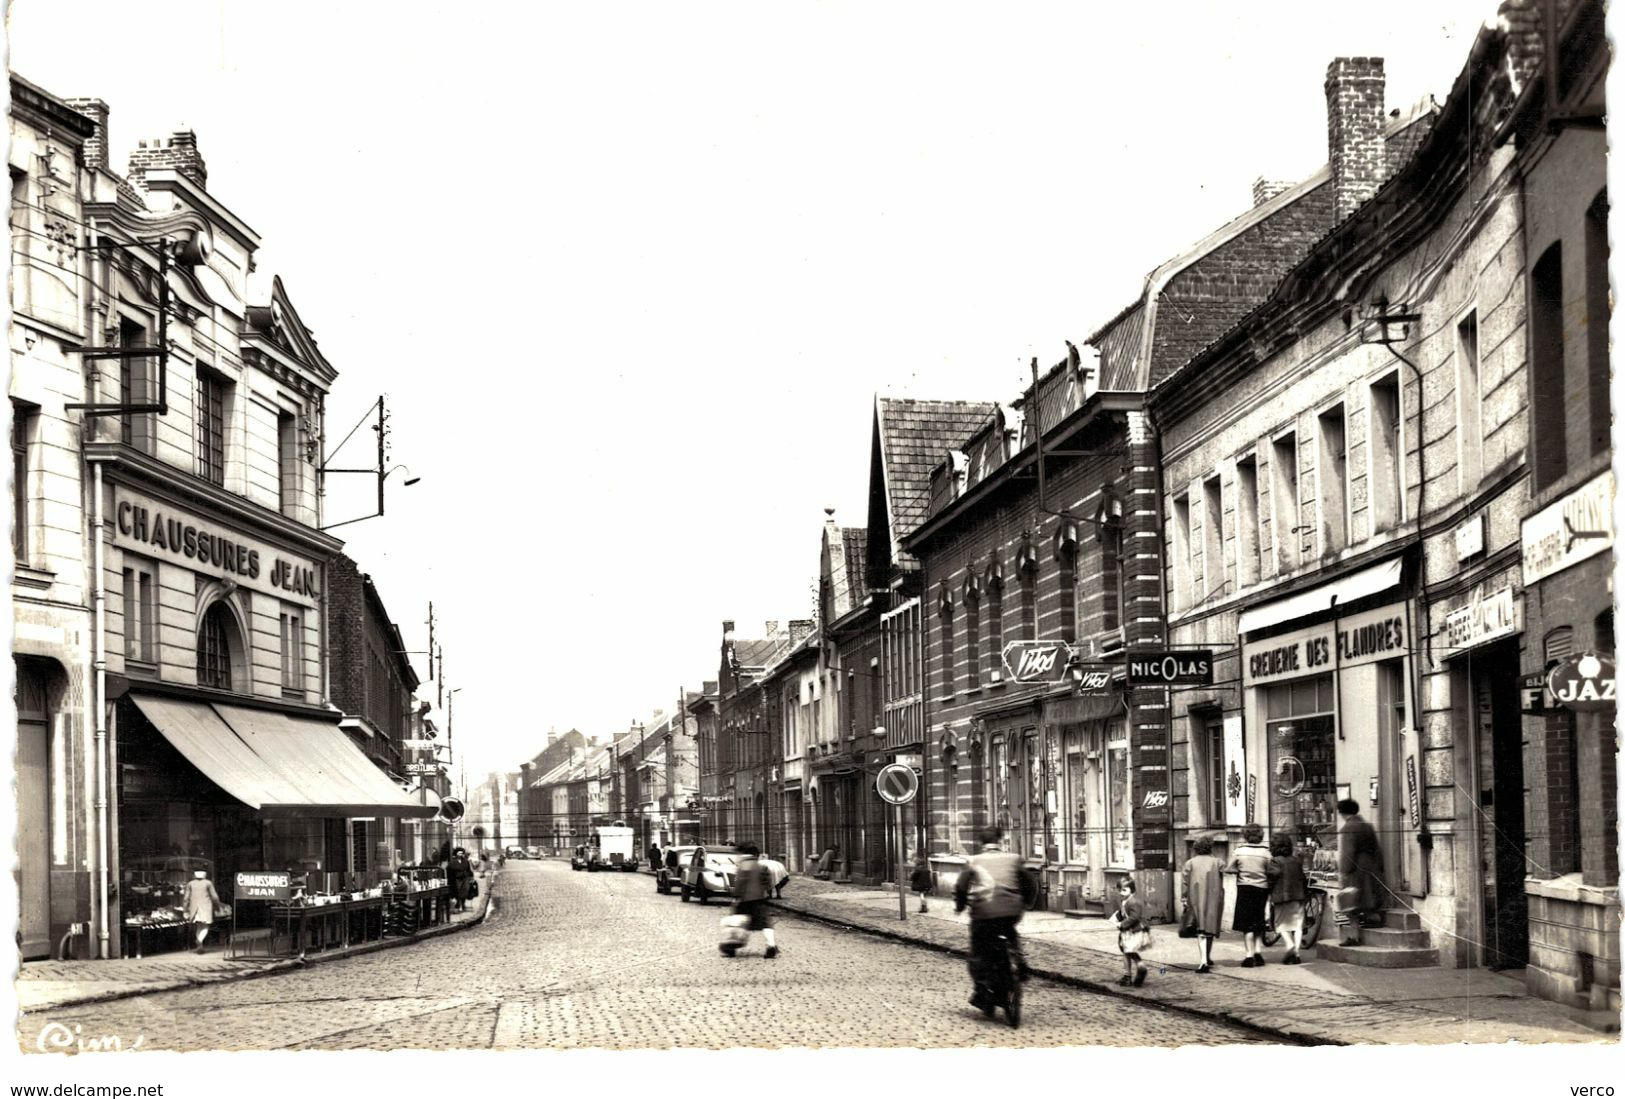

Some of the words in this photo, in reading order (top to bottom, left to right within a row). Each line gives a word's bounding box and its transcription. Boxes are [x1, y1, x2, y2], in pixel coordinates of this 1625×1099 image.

[118, 501, 260, 580] CHAUSSURES
[270, 554, 314, 599] JEAN
[1250, 642, 1299, 679] CREMERIE
[1306, 635, 1329, 668] DES
[1337, 615, 1403, 662] FLANDRES
[1131, 656, 1208, 681] NICOLAS
[1526, 675, 1550, 688] BIJ
[1558, 679, 1616, 702] JAZ
[248, 888, 275, 896] JEAN
